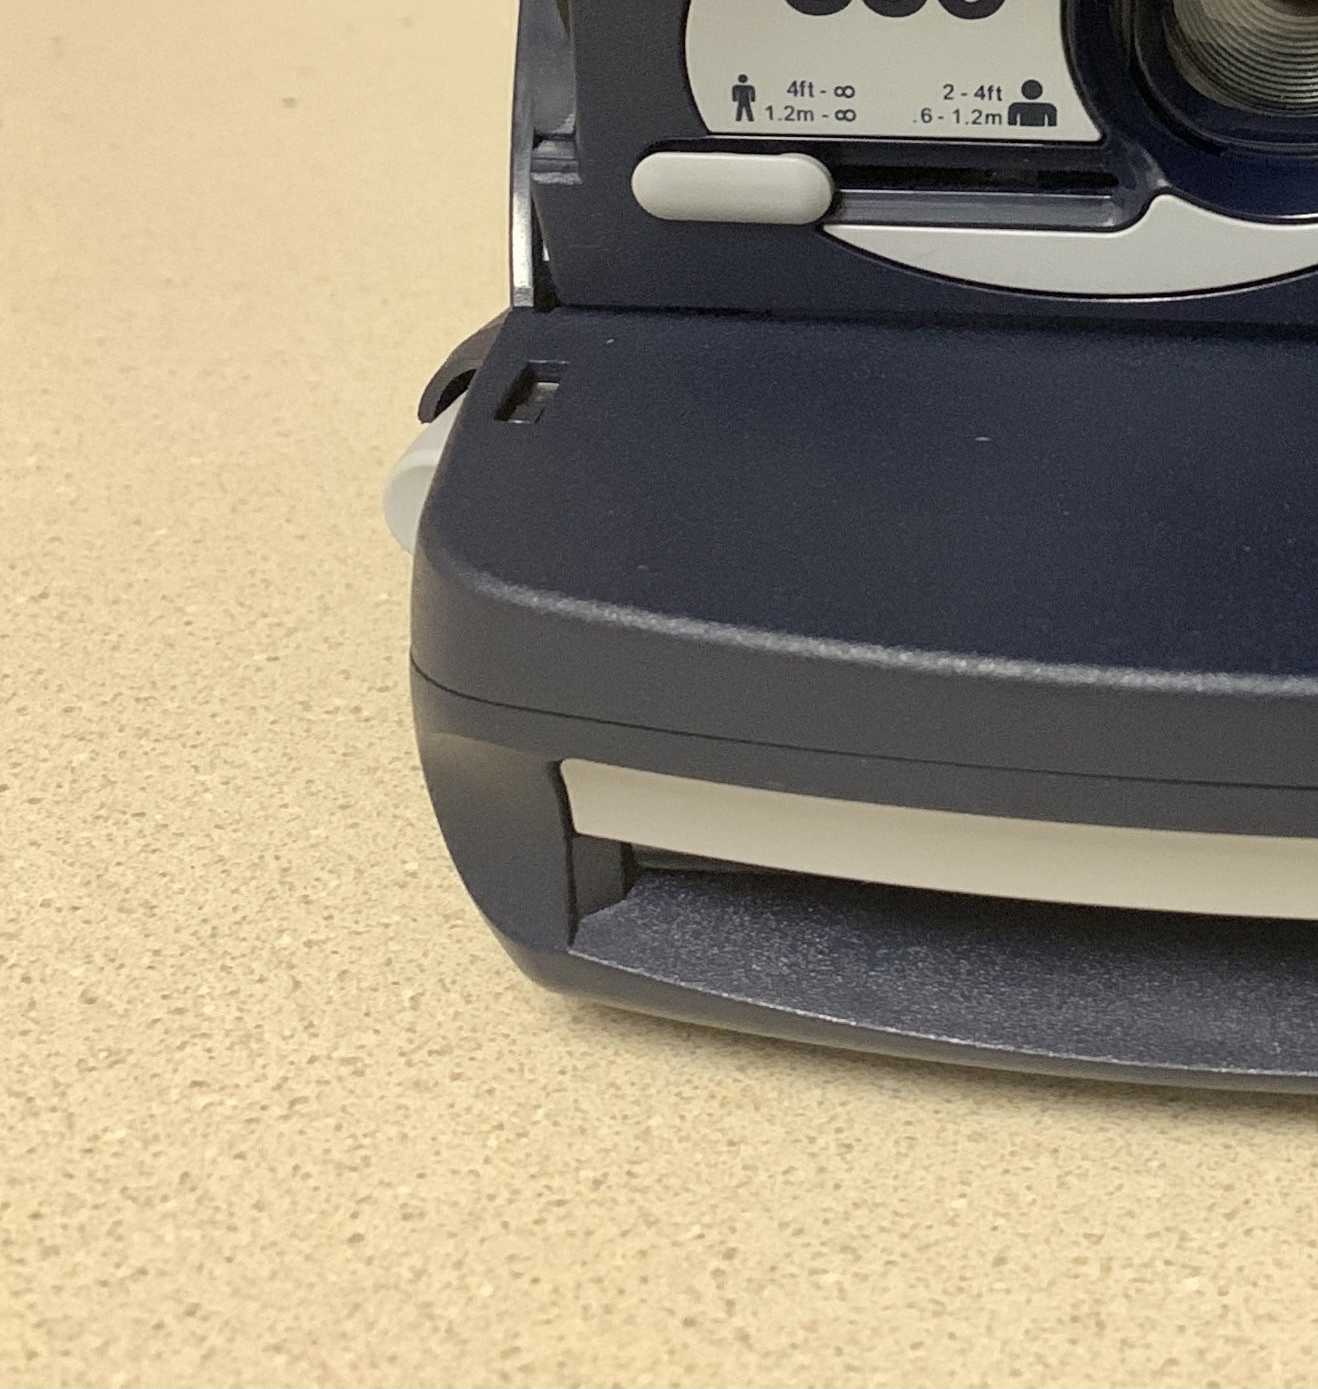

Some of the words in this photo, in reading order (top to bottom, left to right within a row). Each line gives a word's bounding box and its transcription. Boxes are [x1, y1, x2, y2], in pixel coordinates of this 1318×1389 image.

[786, 80, 815, 98] 4ft
[943, 83, 955, 100] 2
[973, 85, 1003, 102] 4ft
[764, 105, 815, 122] 1.2m
[952, 108, 1002, 125] 1.2m
